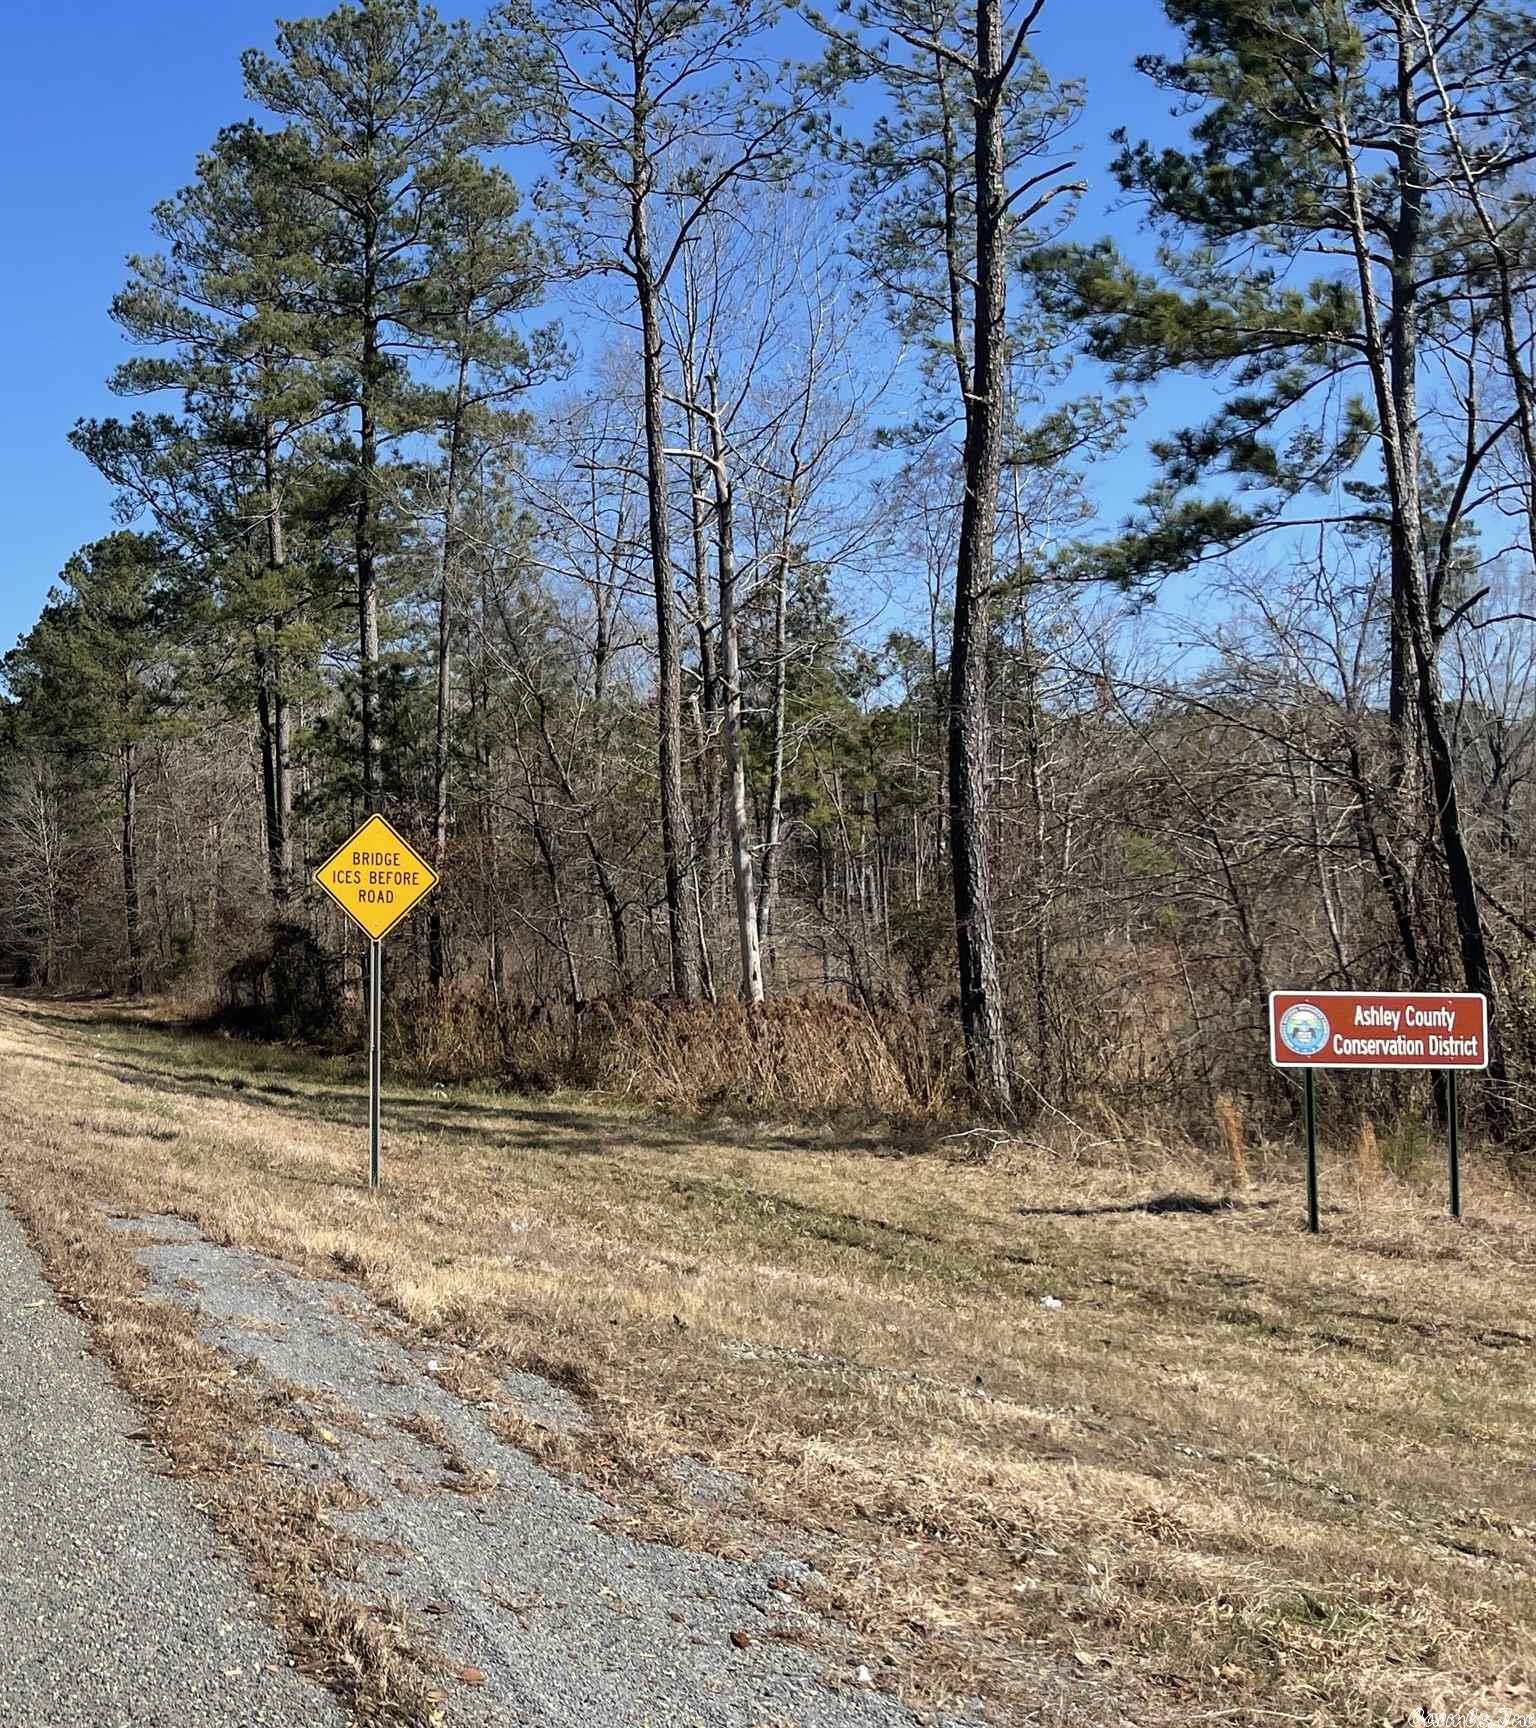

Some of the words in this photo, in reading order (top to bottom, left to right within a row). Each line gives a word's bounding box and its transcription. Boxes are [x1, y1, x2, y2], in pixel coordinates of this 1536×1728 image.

[353, 852, 400, 866] BRIDGE
[332, 870, 362, 884] ICES
[369, 871, 419, 885] BEFORE
[358, 889, 394, 903] ROAD
[1354, 1005, 1401, 1031] Ashley
[1406, 1006, 1455, 1032] County
[1333, 1034, 1424, 1056] Conservation
[1429, 1035, 1478, 1057] District
